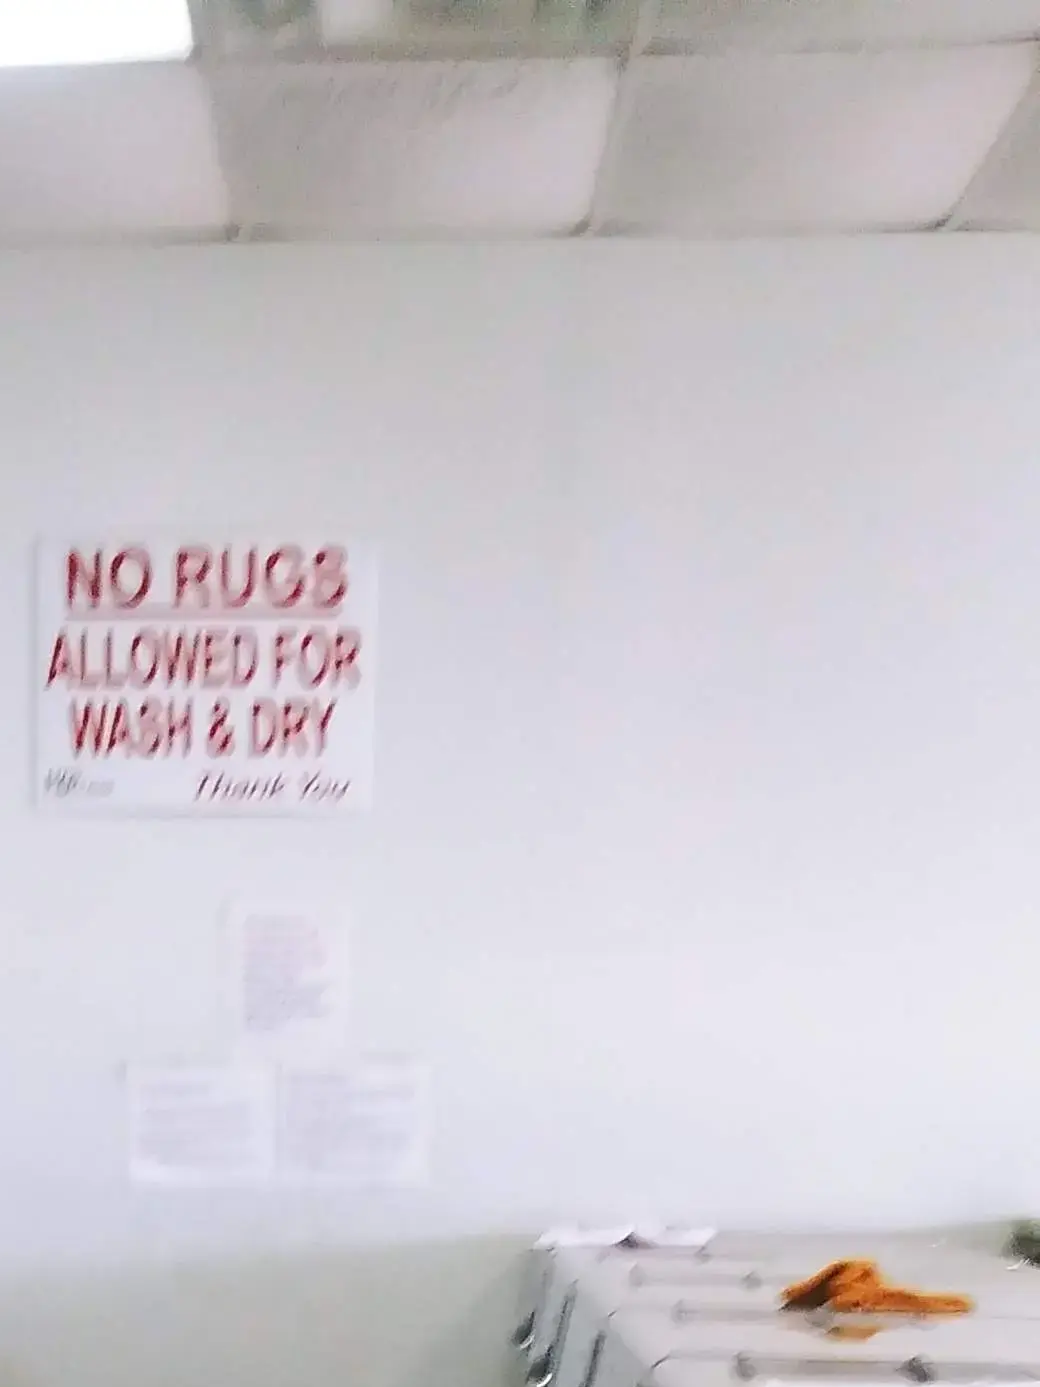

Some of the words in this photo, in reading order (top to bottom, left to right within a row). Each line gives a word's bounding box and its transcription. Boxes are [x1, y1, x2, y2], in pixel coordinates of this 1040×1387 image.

[65, 548, 153, 609] NO
[172, 546, 350, 608] RUGS
[44, 626, 260, 691] ALLOWED
[272, 626, 363, 691] FOR
[69, 696, 195, 760] WASH
[207, 697, 234, 758] &
[249, 696, 338, 759] DRY
